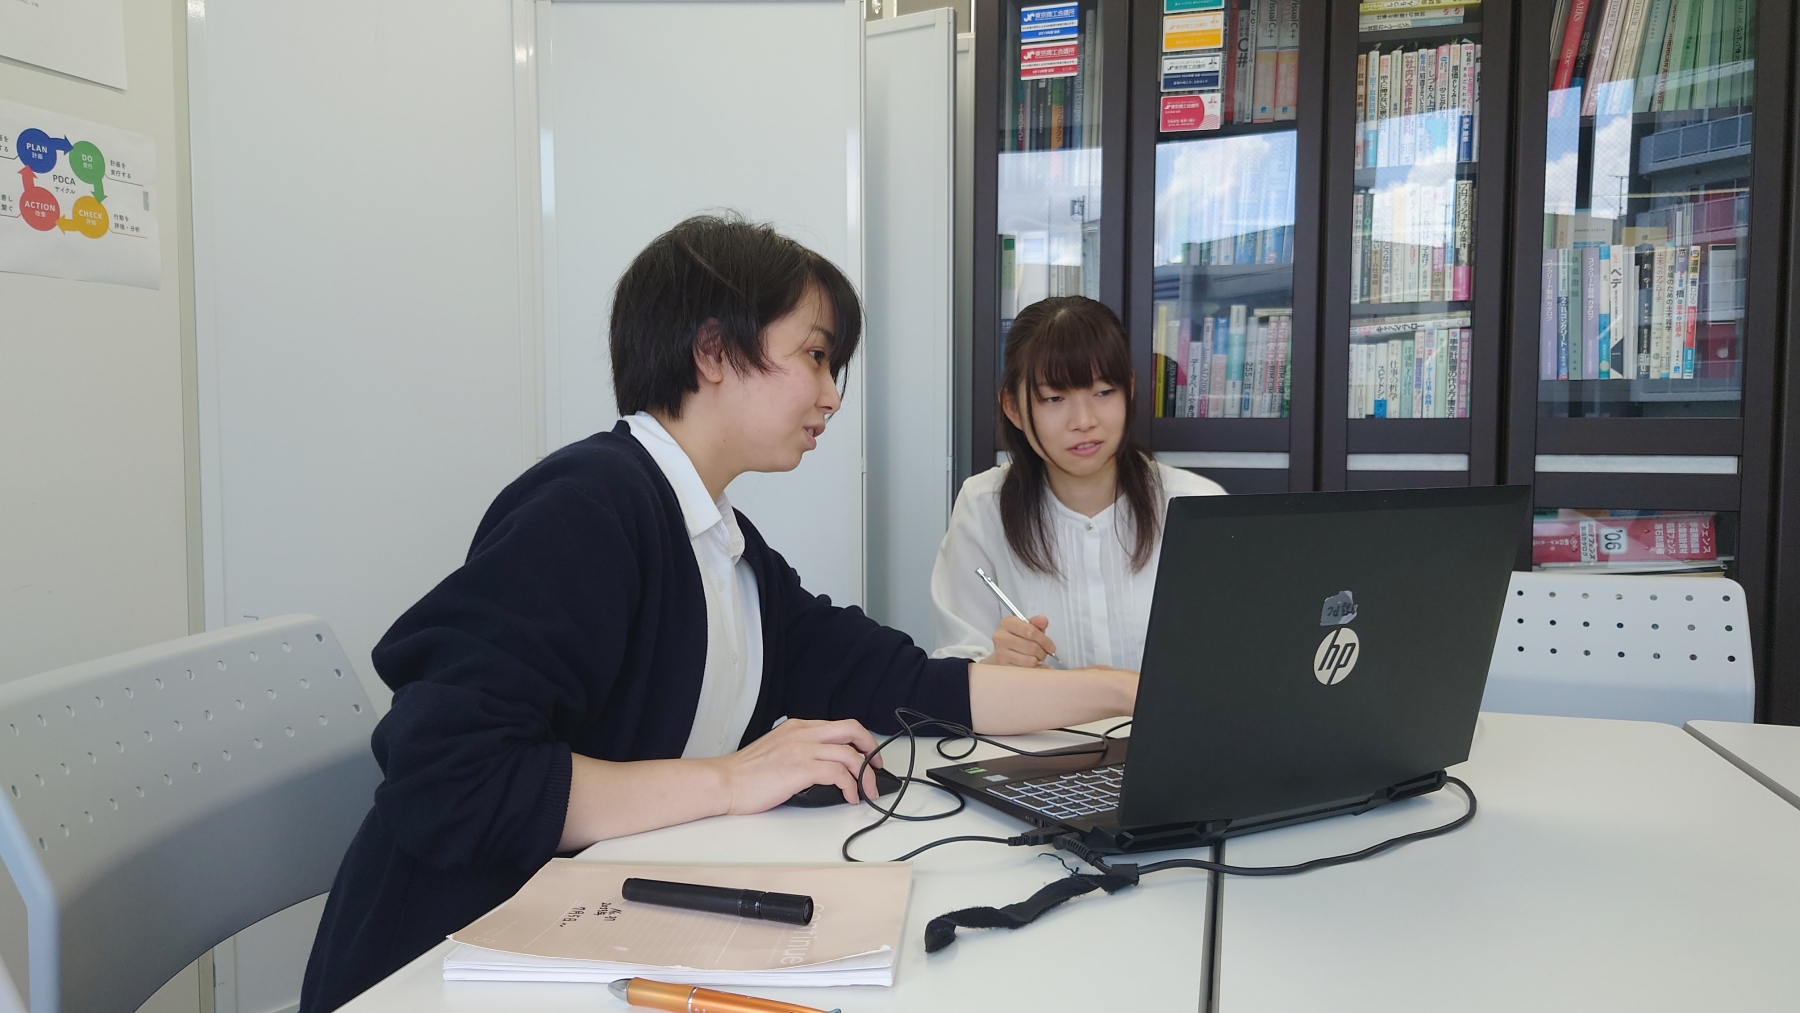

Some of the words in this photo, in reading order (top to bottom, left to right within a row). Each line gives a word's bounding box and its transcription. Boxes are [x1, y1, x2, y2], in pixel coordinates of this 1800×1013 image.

[1268, 22, 1276, 39] C++
[1290, 22, 1299, 39] C++
[1237, 37, 1249, 68] C#
[1074, 92, 1083, 123] Escapes
[26, 142, 48, 154] PLAN
[82, 154, 93, 162] DO
[82, 162, 93, 170] 実行
[110, 160, 126, 169] 計画を
[53, 174, 76, 186] PDCA
[110, 169, 131, 179] 実行する
[55, 186, 76, 195] サイクル
[24, 200, 56, 212] ACTION
[78, 209, 103, 220] CHECK
[114, 214, 129, 222] 行動を
[1459, 183, 1468, 249] プロフェッショナルの条件
[86, 218, 97, 226] 評価
[114, 222, 140, 233] 評価・分析
[1655, 252, 1664, 303] 土木へのアプローチ
[1604, 529, 1621, 551] '06
[1702, 521, 1711, 554] フェンス
[1317, 628, 1356, 685] hp
